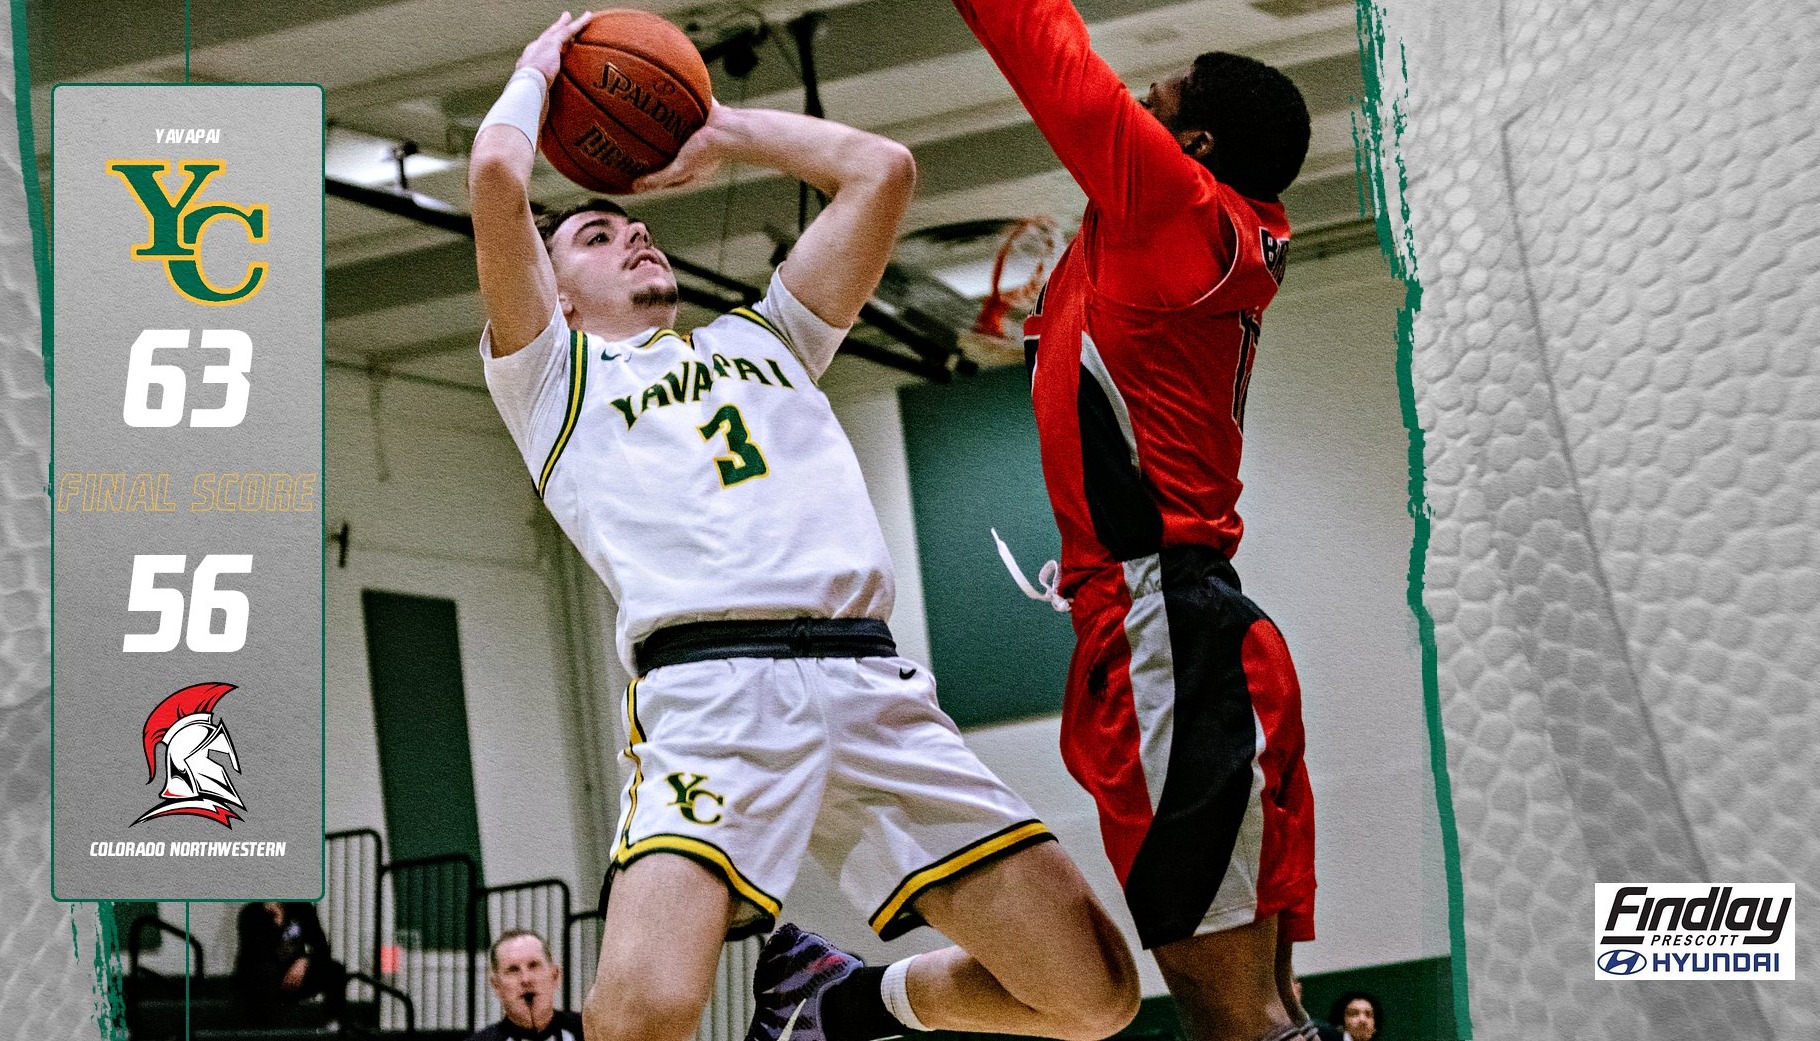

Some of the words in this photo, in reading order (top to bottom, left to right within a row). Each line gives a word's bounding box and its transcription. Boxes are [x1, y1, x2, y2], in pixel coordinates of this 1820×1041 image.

[592, 61, 692, 142] SPALDIN
[609, 353, 796, 431] YAVAPAI
[695, 402, 770, 489] 3
[664, 771, 725, 826] YC
